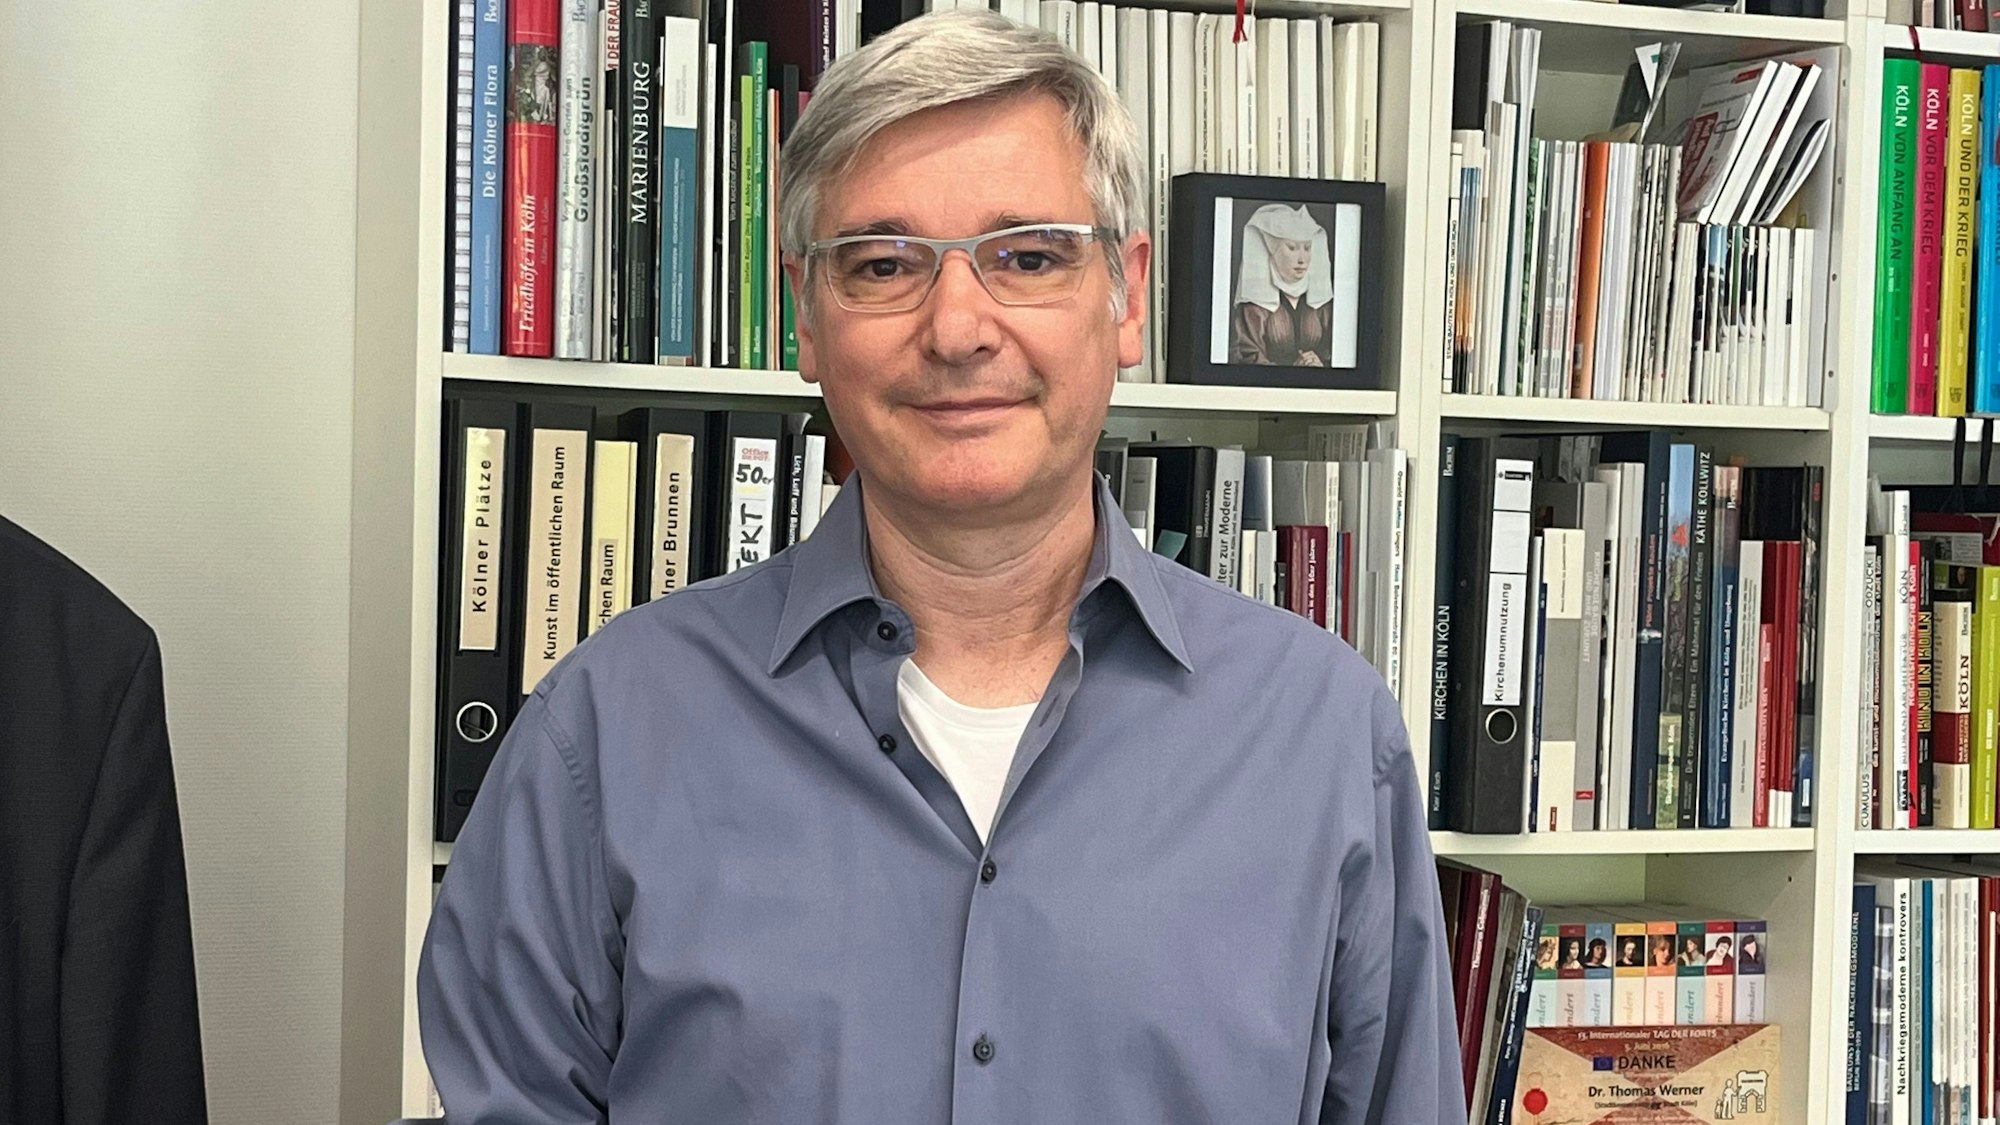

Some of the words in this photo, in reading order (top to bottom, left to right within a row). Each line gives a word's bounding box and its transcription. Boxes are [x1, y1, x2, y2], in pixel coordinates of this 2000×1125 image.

[608, 37, 619, 58] DER
[484, 64, 499, 105] Flora
[1895, 84, 1910, 127] KÖLN
[1925, 88, 1940, 130] KÖLN
[1961, 93, 1975, 135] KÖLN
[483, 112, 498, 164] Kölner
[575, 76, 593, 222] Großstadtgrün
[630, 61, 651, 224] MARIENBURG
[1894, 131, 1907, 165] VON
[1925, 135, 1936, 165] VOR
[1959, 138, 1972, 172] UND
[483, 171, 495, 197] Die
[1891, 168, 1906, 233] ANFANG
[1923, 171, 1936, 204] DEM
[1958, 176, 1971, 207] DER
[520, 194, 536, 233] Köln
[1921, 208, 1934, 255] KRIEG
[521, 240, 535, 254] in
[1889, 237, 1903, 260] AN
[1956, 212, 1969, 257] KRIEG
[520, 256, 538, 332] Friedhöfe
[1446, 309, 1454, 360] STAHLBAUTEN
[551, 446, 565, 489] Raum
[1396, 471, 1404, 498] Oswald
[1697, 451, 1710, 505] KOLLWITZ
[475, 459, 492, 527] Plätze
[790, 497, 799, 516] und
[1218, 480, 1233, 535] Moderne
[663, 472, 680, 552] Brunnen
[1694, 509, 1708, 544] KÄTHE
[547, 495, 563, 588] öffentlichen
[1219, 538, 1229, 558] zur
[1308, 538, 1317, 563] Jahren
[1393, 530, 1402, 557] Ungers
[1648, 534, 1656, 565] Bauten
[472, 539, 489, 612] Kölner
[600, 544, 614, 586] Raum
[1694, 551, 1704, 581] Frieden
[1909, 564, 1917, 592] Köln
[1646, 566, 1655, 602] Projekte
[1693, 583, 1702, 600] den
[1864, 560, 1874, 608] ODZUCK
[1897, 569, 1908, 604] KÖLN
[545, 594, 559, 611] im
[1692, 602, 1701, 615] für
[1724, 584, 1735, 627] Umgebung
[543, 617, 558, 660] Kunst
[1434, 605, 1450, 640] KÖLN
[1689, 617, 1701, 657] Mahnmal
[1723, 629, 1732, 645] und
[1917, 611, 1932, 660] KÖLN
[1435, 644, 1449, 657] IN
[1494, 582, 1512, 702] Kirchenumnutzung
[1722, 647, 1732, 666] Köln
[1908, 595, 1916, 707] Rechtsrheinisches
[1689, 659, 1698, 673] Ein
[1722, 667, 1731, 677] in
[1916, 663, 1931, 684] IN
[1957, 654, 1969, 709] KÖLN
[1434, 662, 1448, 719] KIRCHEN
[1687, 683, 1697, 709] Eltern
[1721, 678, 1731, 710] Kirchen
[1916, 687, 1931, 732] KINO
[1666, 724, 1675, 743] Köln
[1685, 711, 1696, 757] trauernden
[1720, 711, 1730, 762] Evangelische
[1872, 724, 1880, 752] kunst-
[1684, 759, 1693, 773] Die
[1861, 773, 1870, 828] CUMULUS
[1897, 892, 1908, 962] kontrovers
[1848, 911, 1859, 1018] NACHKRIEGSMODERNE
[1590, 1029, 1651, 1040] Internationaler
[1653, 1028, 1670, 1039] TAG
[1671, 1028, 1688, 1038] DER
[1847, 1020, 1855, 1039] DER
[1896, 965, 1908, 1095] Nachkriegsmoderne
[1618, 1055, 1676, 1070] DANKE
[1846, 1041, 1855, 1092] BAUKUNST
[1588, 1086, 1605, 1097] Dr.
[1609, 1085, 1657, 1097] Thomas
[1660, 1085, 1704, 1096] Werner
